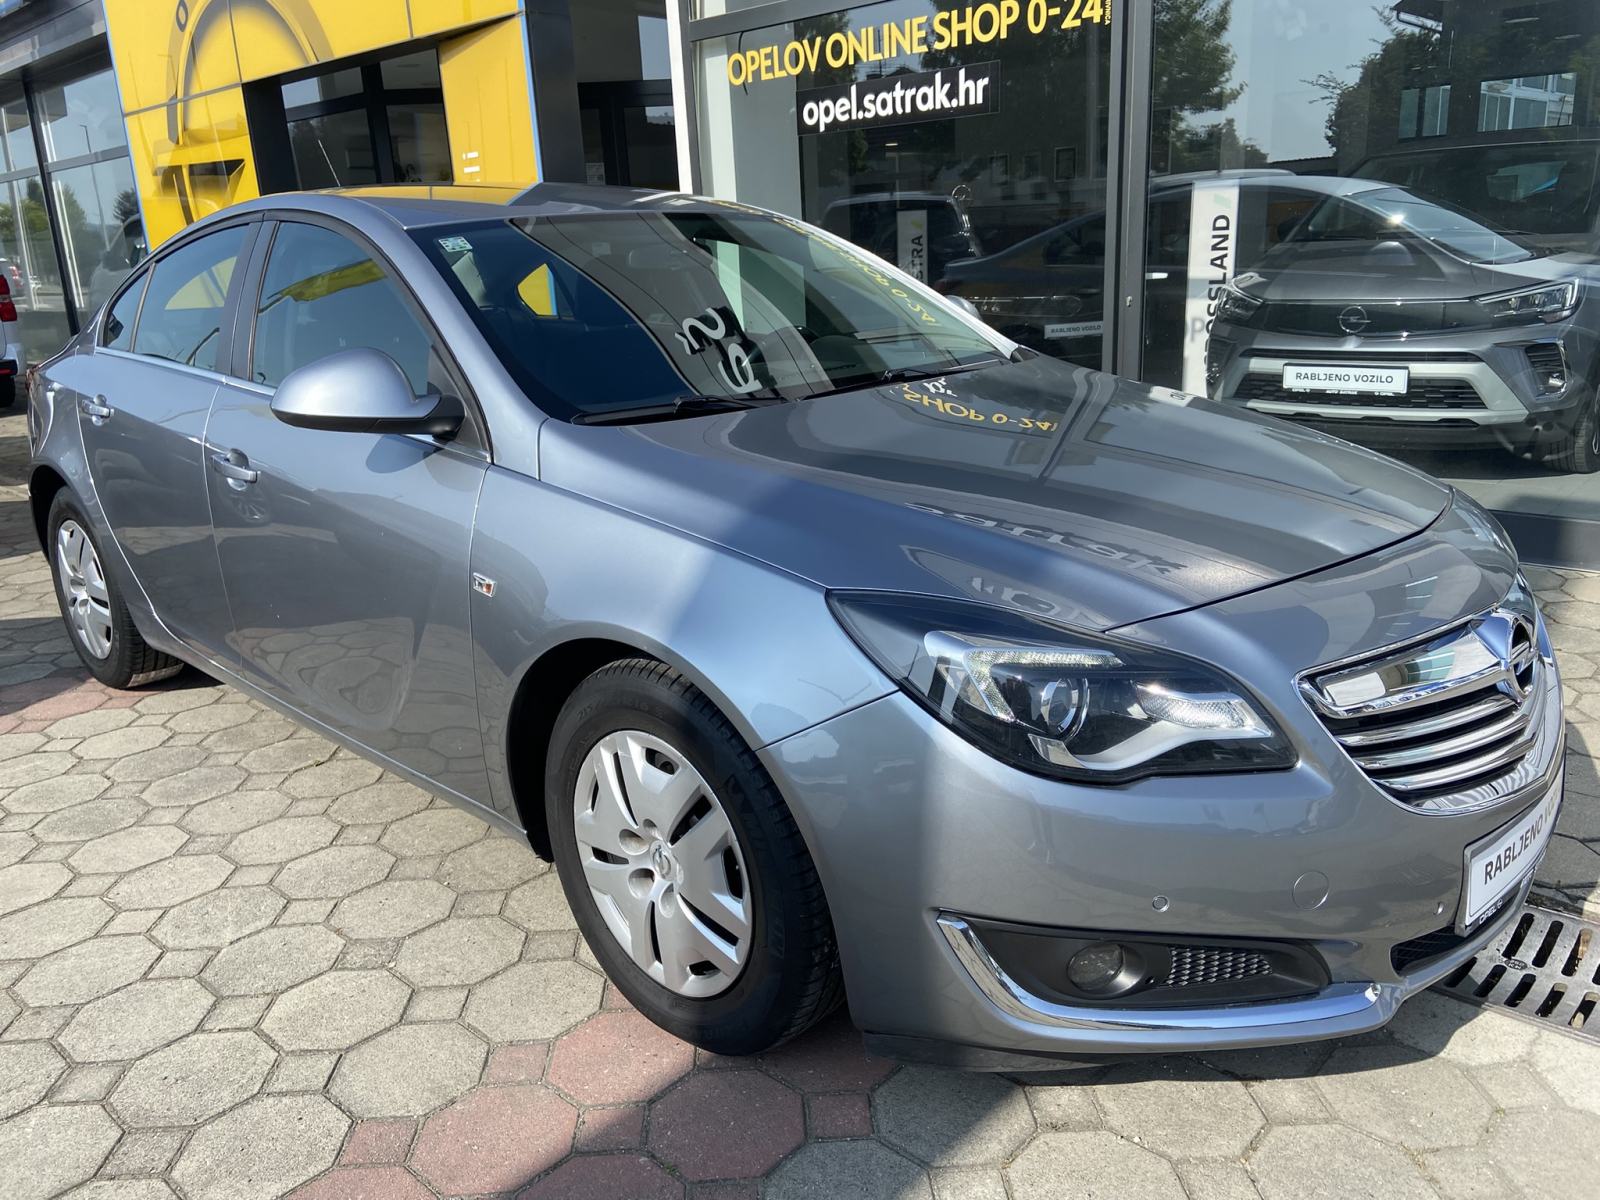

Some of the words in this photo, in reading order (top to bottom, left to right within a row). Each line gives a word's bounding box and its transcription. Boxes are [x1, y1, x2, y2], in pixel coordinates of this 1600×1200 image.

[728, 36, 821, 86] OPELOV
[825, 16, 929, 68] ONLINE
[933, 0, 1020, 51] SHOP
[1027, 0, 1103, 34] 0-24
[802, 67, 989, 132] opel.satrak.hr
[911, 235, 924, 283] STRA
[1295, 372, 1351, 382] RABLJENO
[1354, 374, 1394, 384] VOZILO
[1484, 814, 1543, 885] RABLJENO
